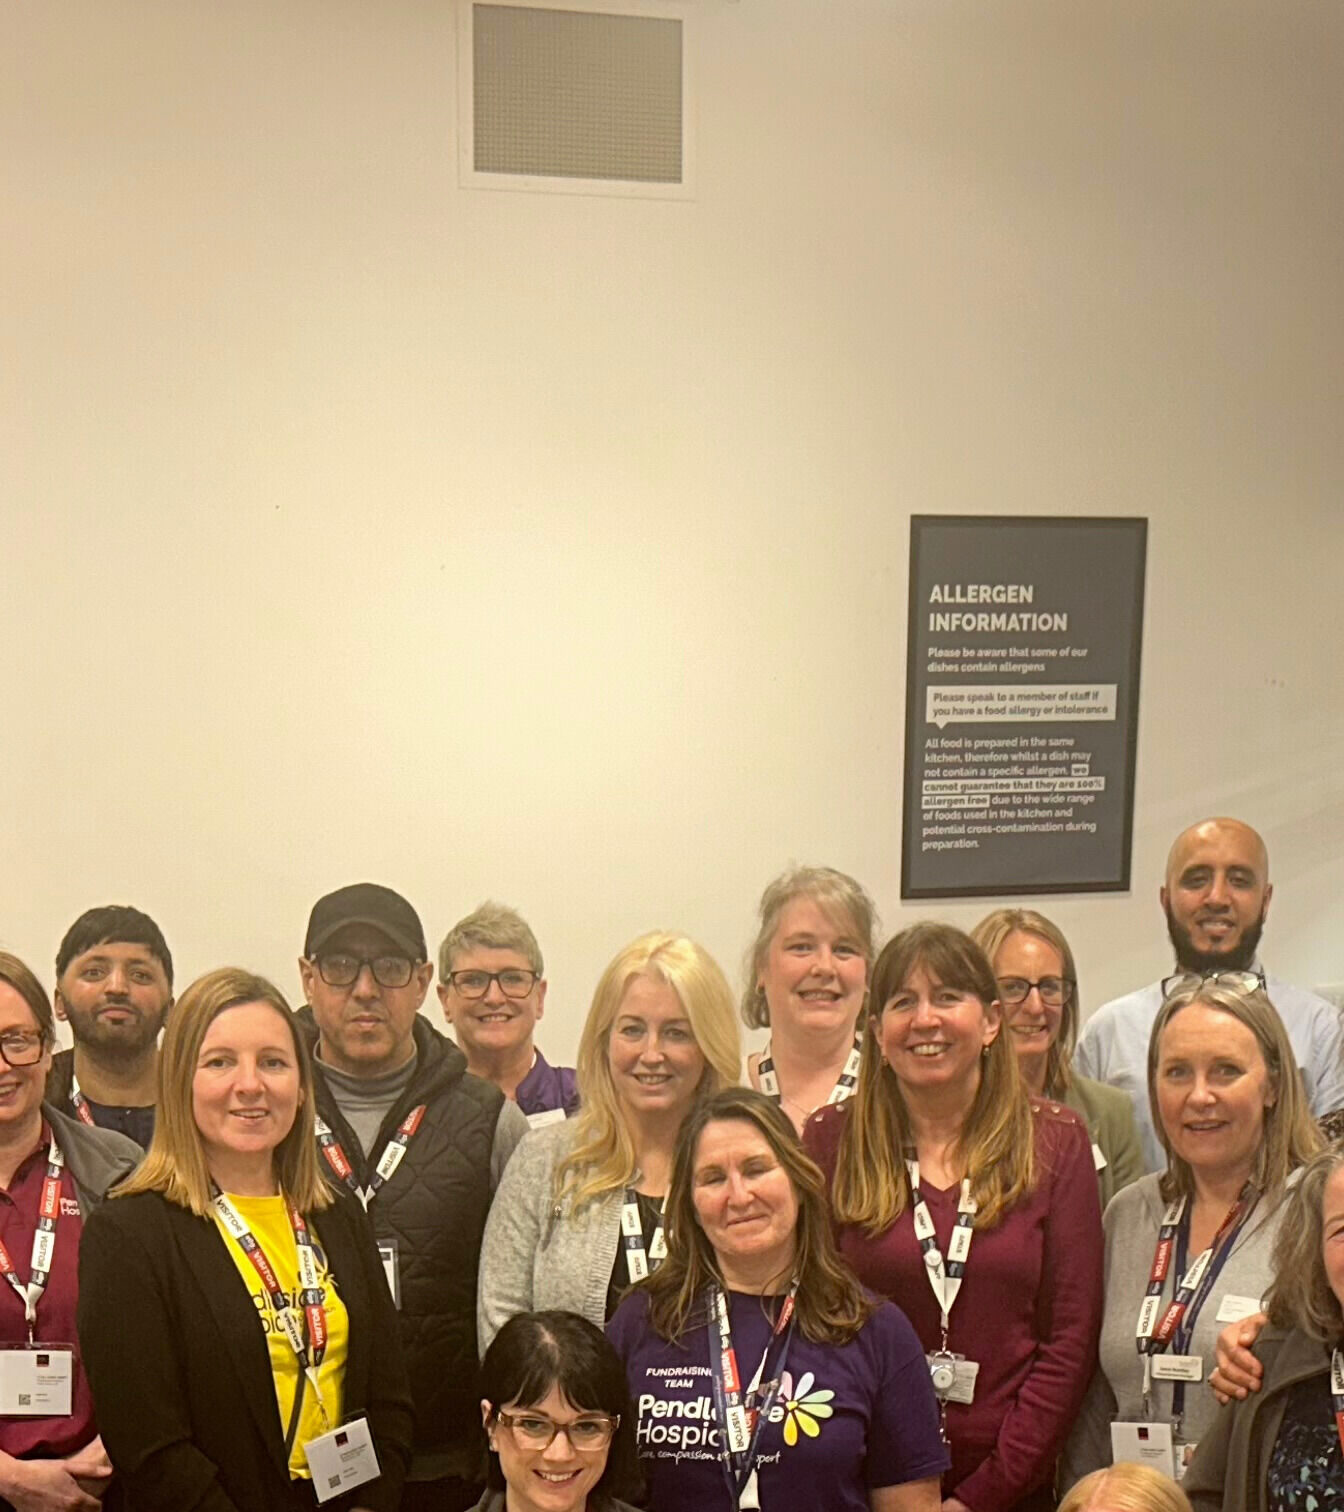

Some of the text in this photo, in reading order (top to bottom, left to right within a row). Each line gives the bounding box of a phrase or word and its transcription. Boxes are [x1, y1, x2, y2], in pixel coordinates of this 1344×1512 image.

[929, 585, 1033, 603] ALLERGEN
[929, 613, 1068, 631] INFORMATION
[928, 647, 961, 658] Please
[977, 649, 1006, 657] aware
[1009, 647, 1029, 657] that
[927, 662, 1045, 674] dishes contain allergens
[216, 1199, 243, 1232] VISITOR
[253, 1251, 277, 1289] VISITOR
[1158, 1305, 1180, 1339] VISITOR
[664, 1379, 694, 1388] TEAM
[636, 1420, 721, 1449] Hospic
[732, 1412, 745, 1448] VISITOR
